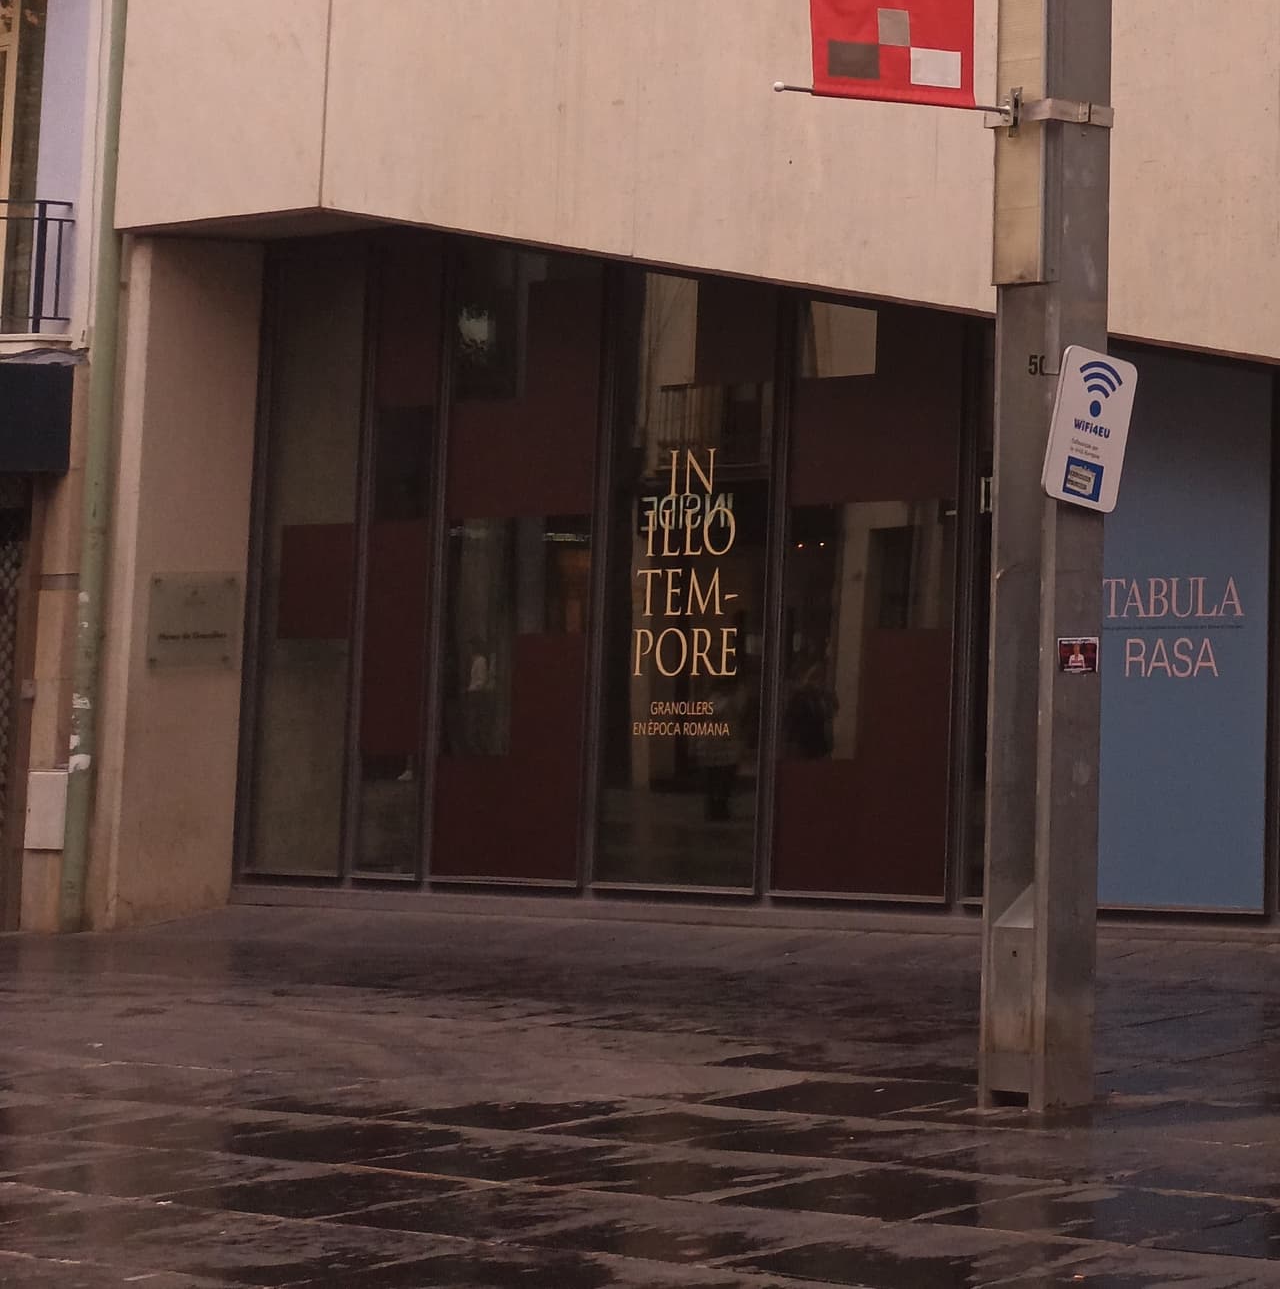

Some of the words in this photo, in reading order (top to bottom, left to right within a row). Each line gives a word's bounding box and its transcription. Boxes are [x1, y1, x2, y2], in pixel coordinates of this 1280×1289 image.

[1073, 417, 1112, 440] WiFi4EU
[670, 447, 717, 497] IN
[645, 507, 736, 557] ILLO
[637, 566, 739, 617] TEM-
[1102, 576, 1246, 618] TABULA
[633, 627, 738, 676] PORE
[1125, 637, 1219, 677] RASA
[632, 722, 646, 736] EN
[683, 721, 731, 736] ROMANA
[650, 701, 714, 716] GRANOLLERS
